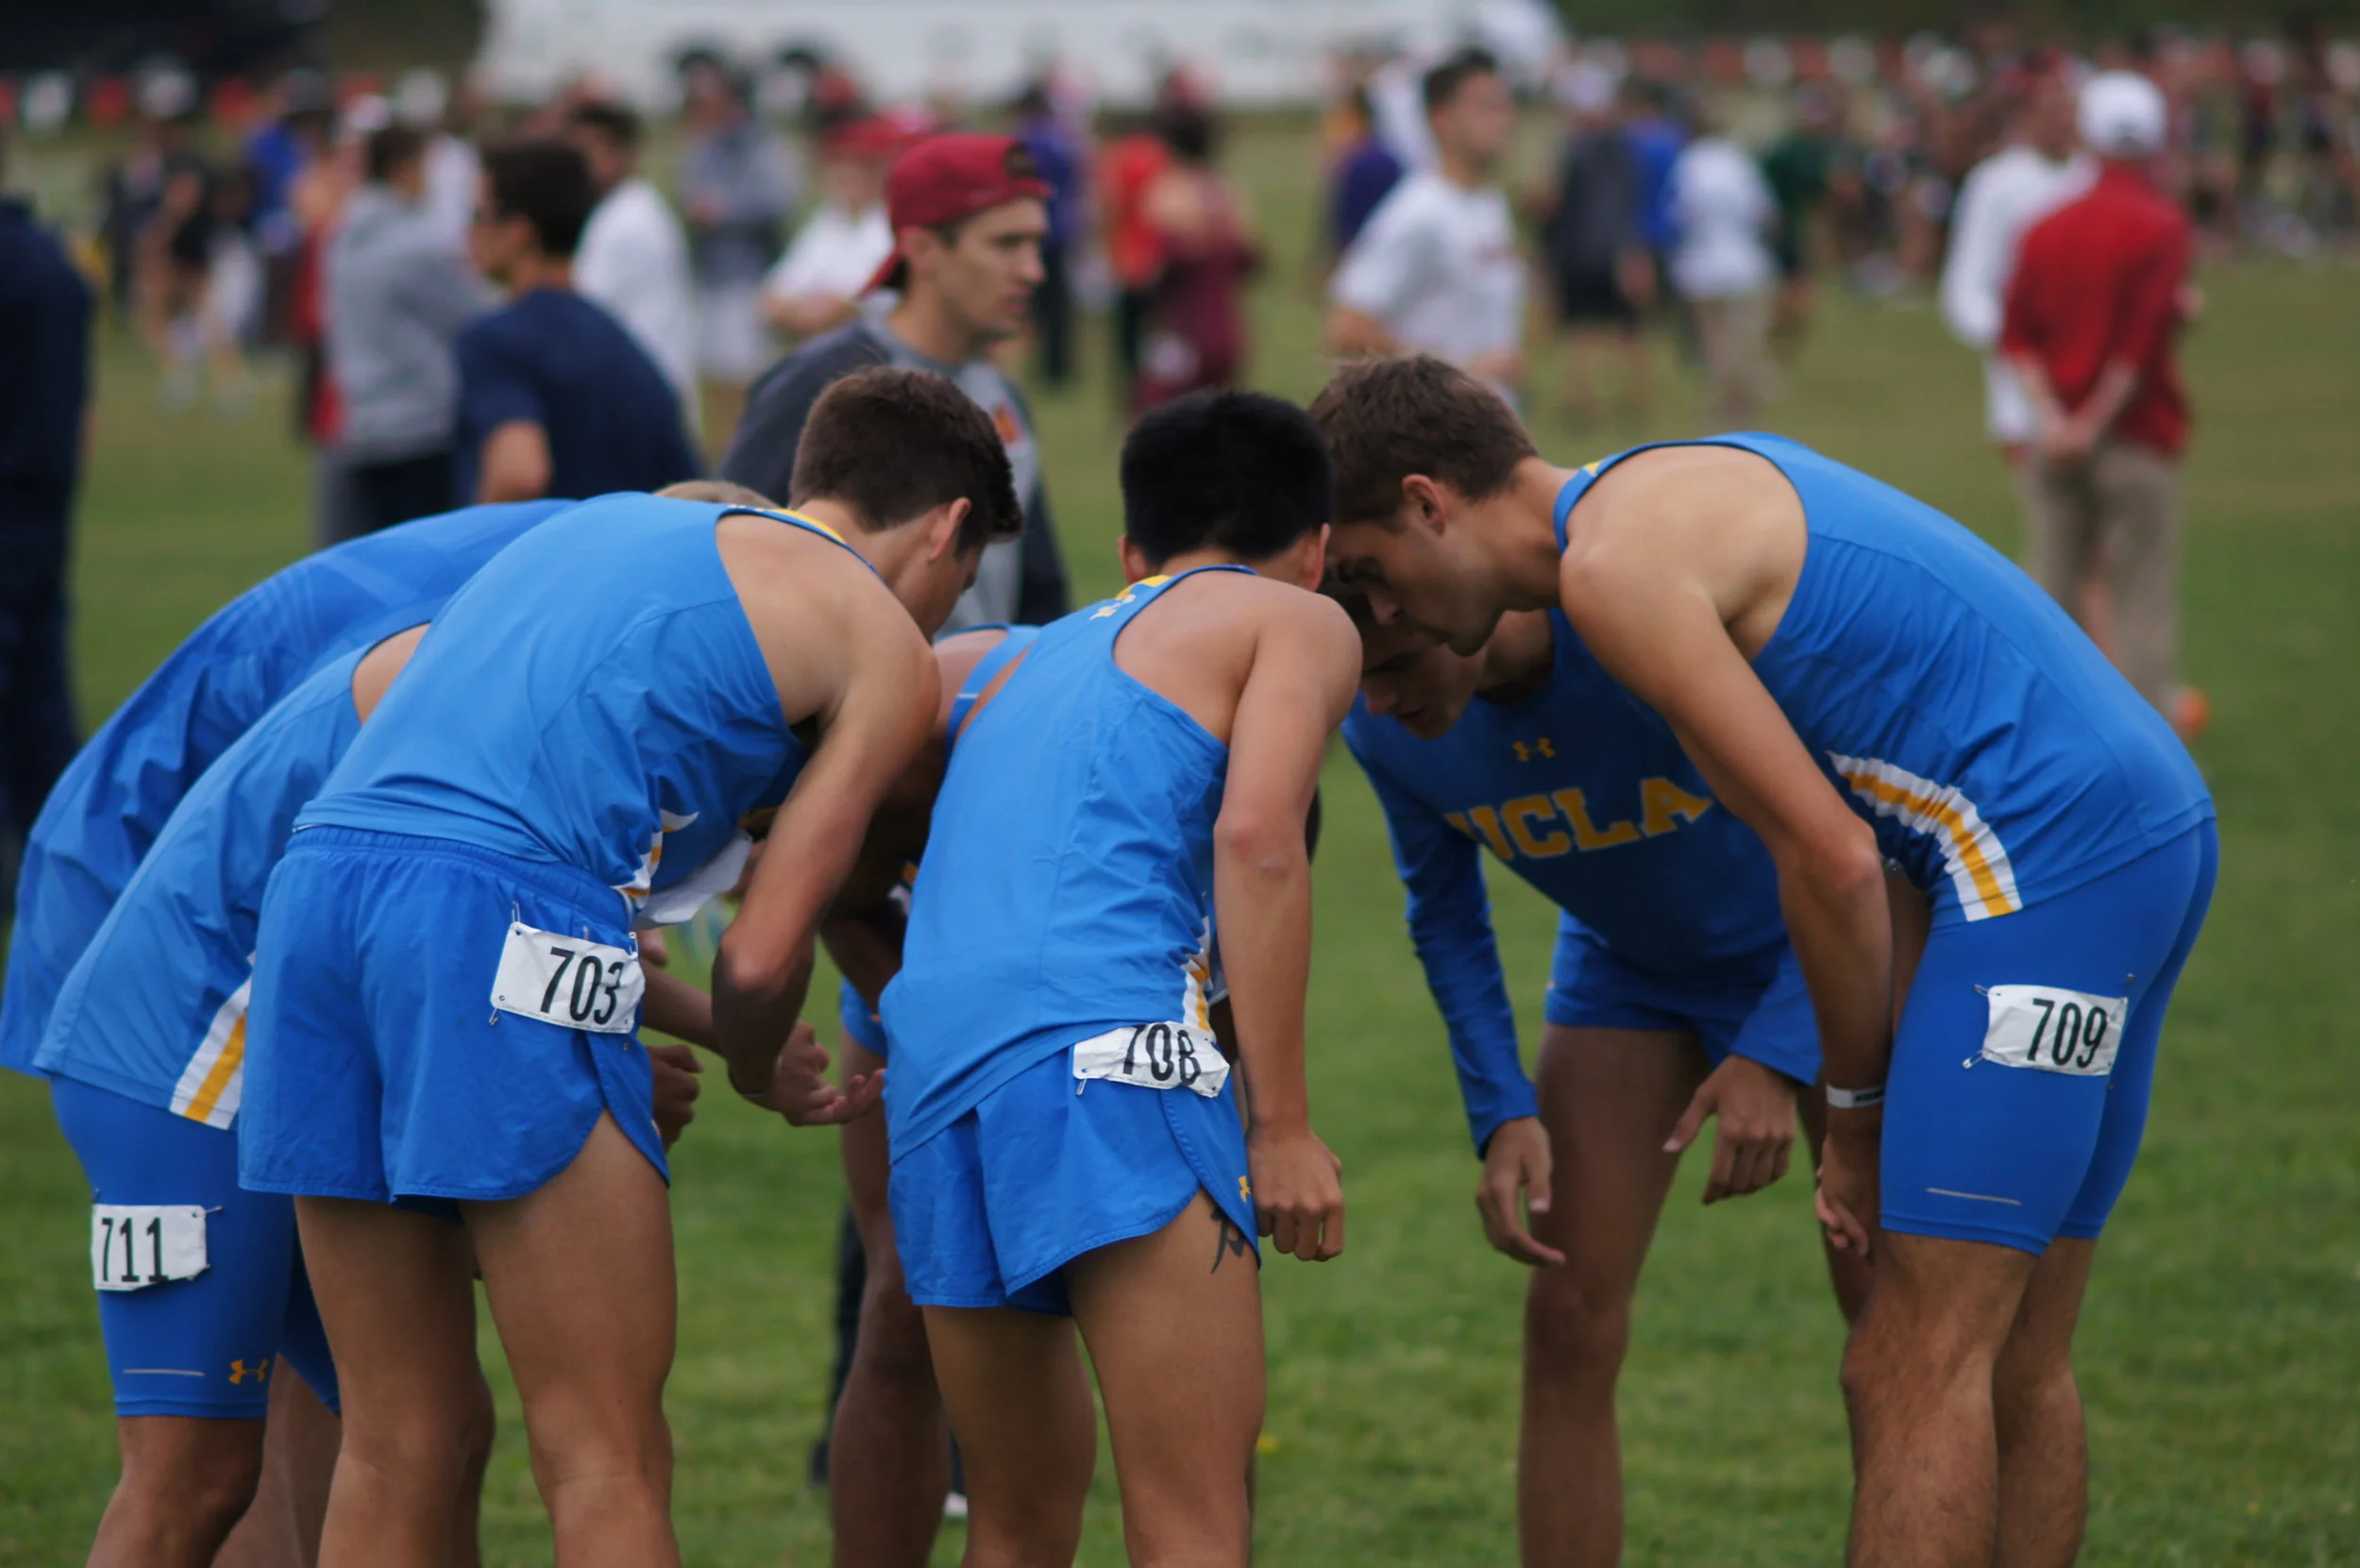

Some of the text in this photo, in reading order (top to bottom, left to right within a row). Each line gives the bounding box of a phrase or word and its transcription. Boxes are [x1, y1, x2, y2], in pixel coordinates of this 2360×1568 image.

[540, 947, 626, 1025] 703
[1122, 1023, 1201, 1086] 708
[2027, 998, 2109, 1069] 709
[101, 1217, 169, 1283] 711
